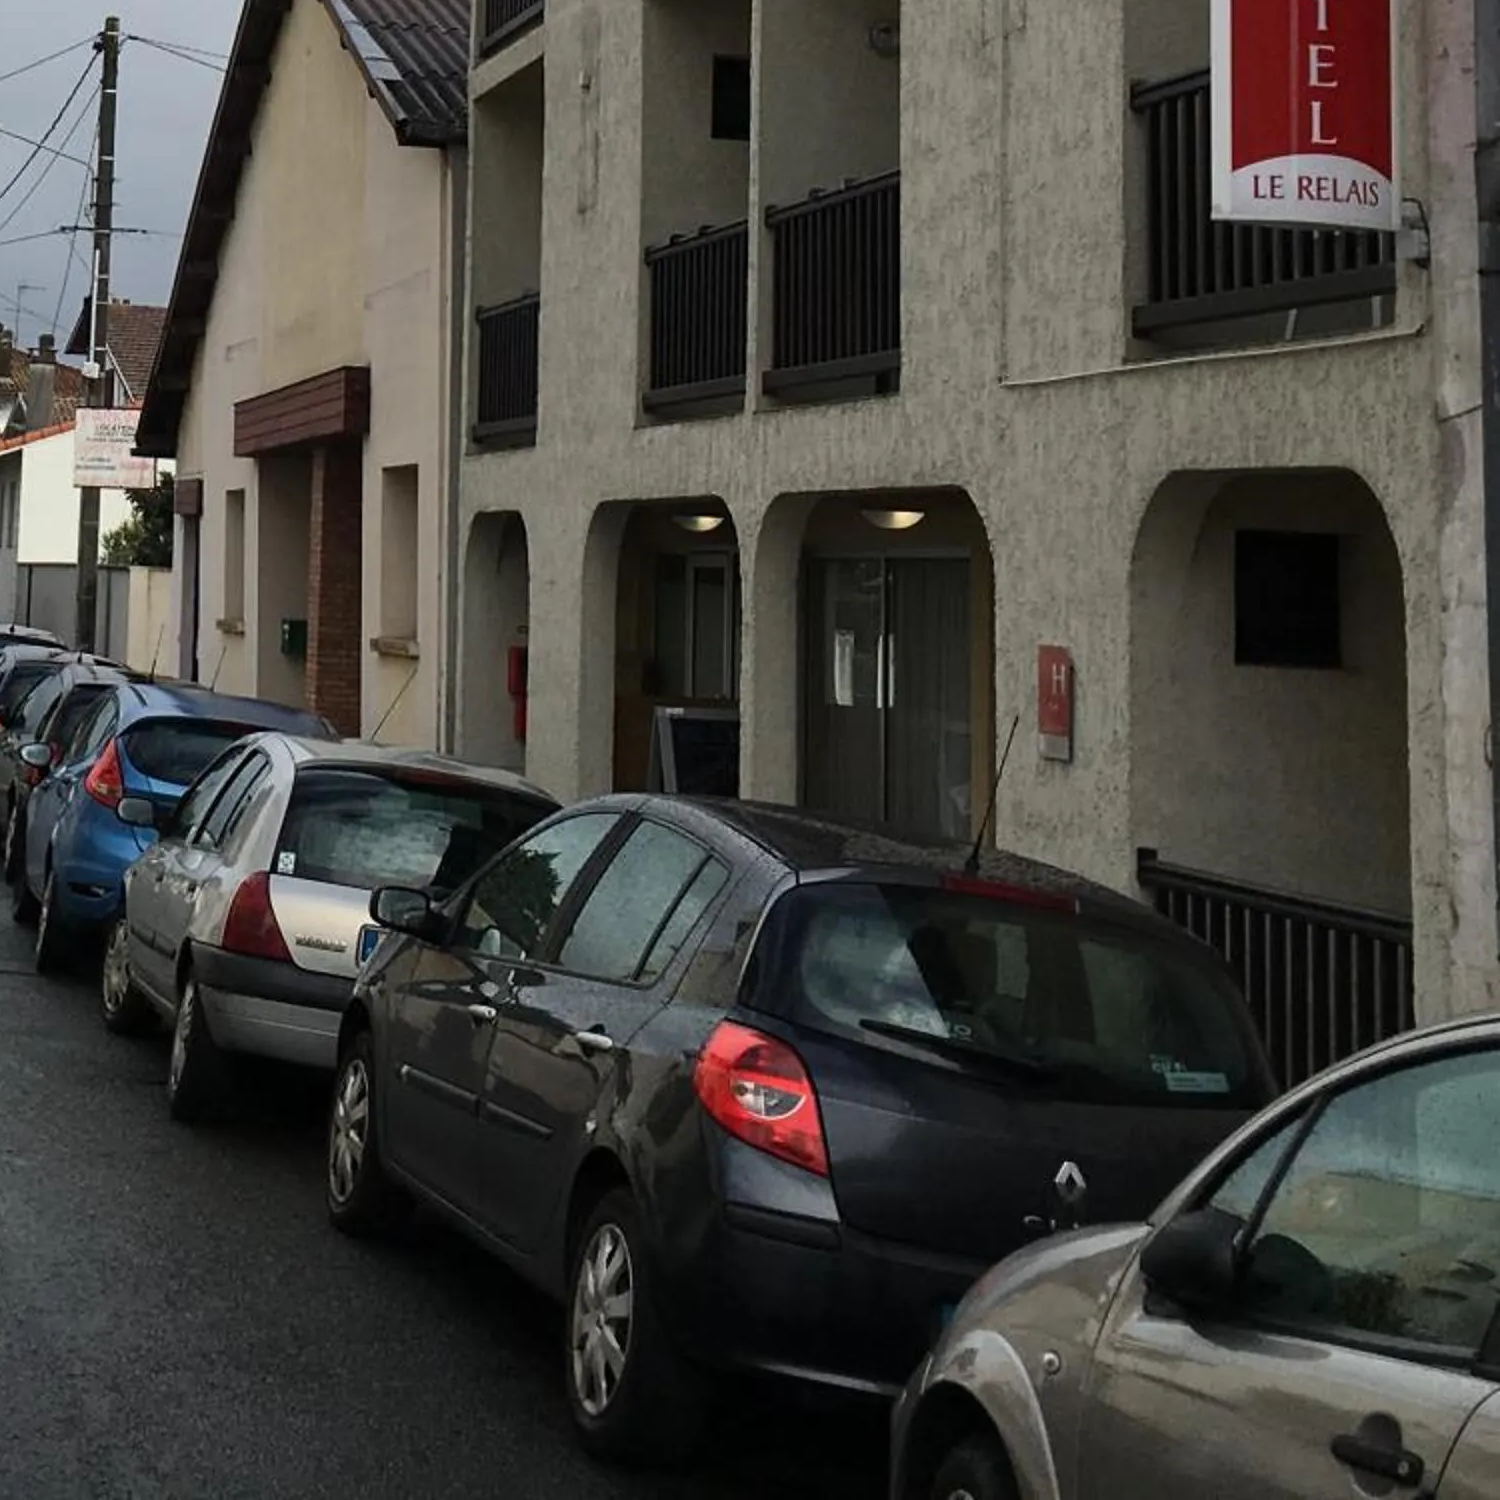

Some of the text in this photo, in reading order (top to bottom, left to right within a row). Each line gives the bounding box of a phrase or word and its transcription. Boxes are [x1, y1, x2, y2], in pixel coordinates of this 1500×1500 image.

[1253, 175, 1380, 206] LE RELAIS
[1051, 663, 1066, 695] H
